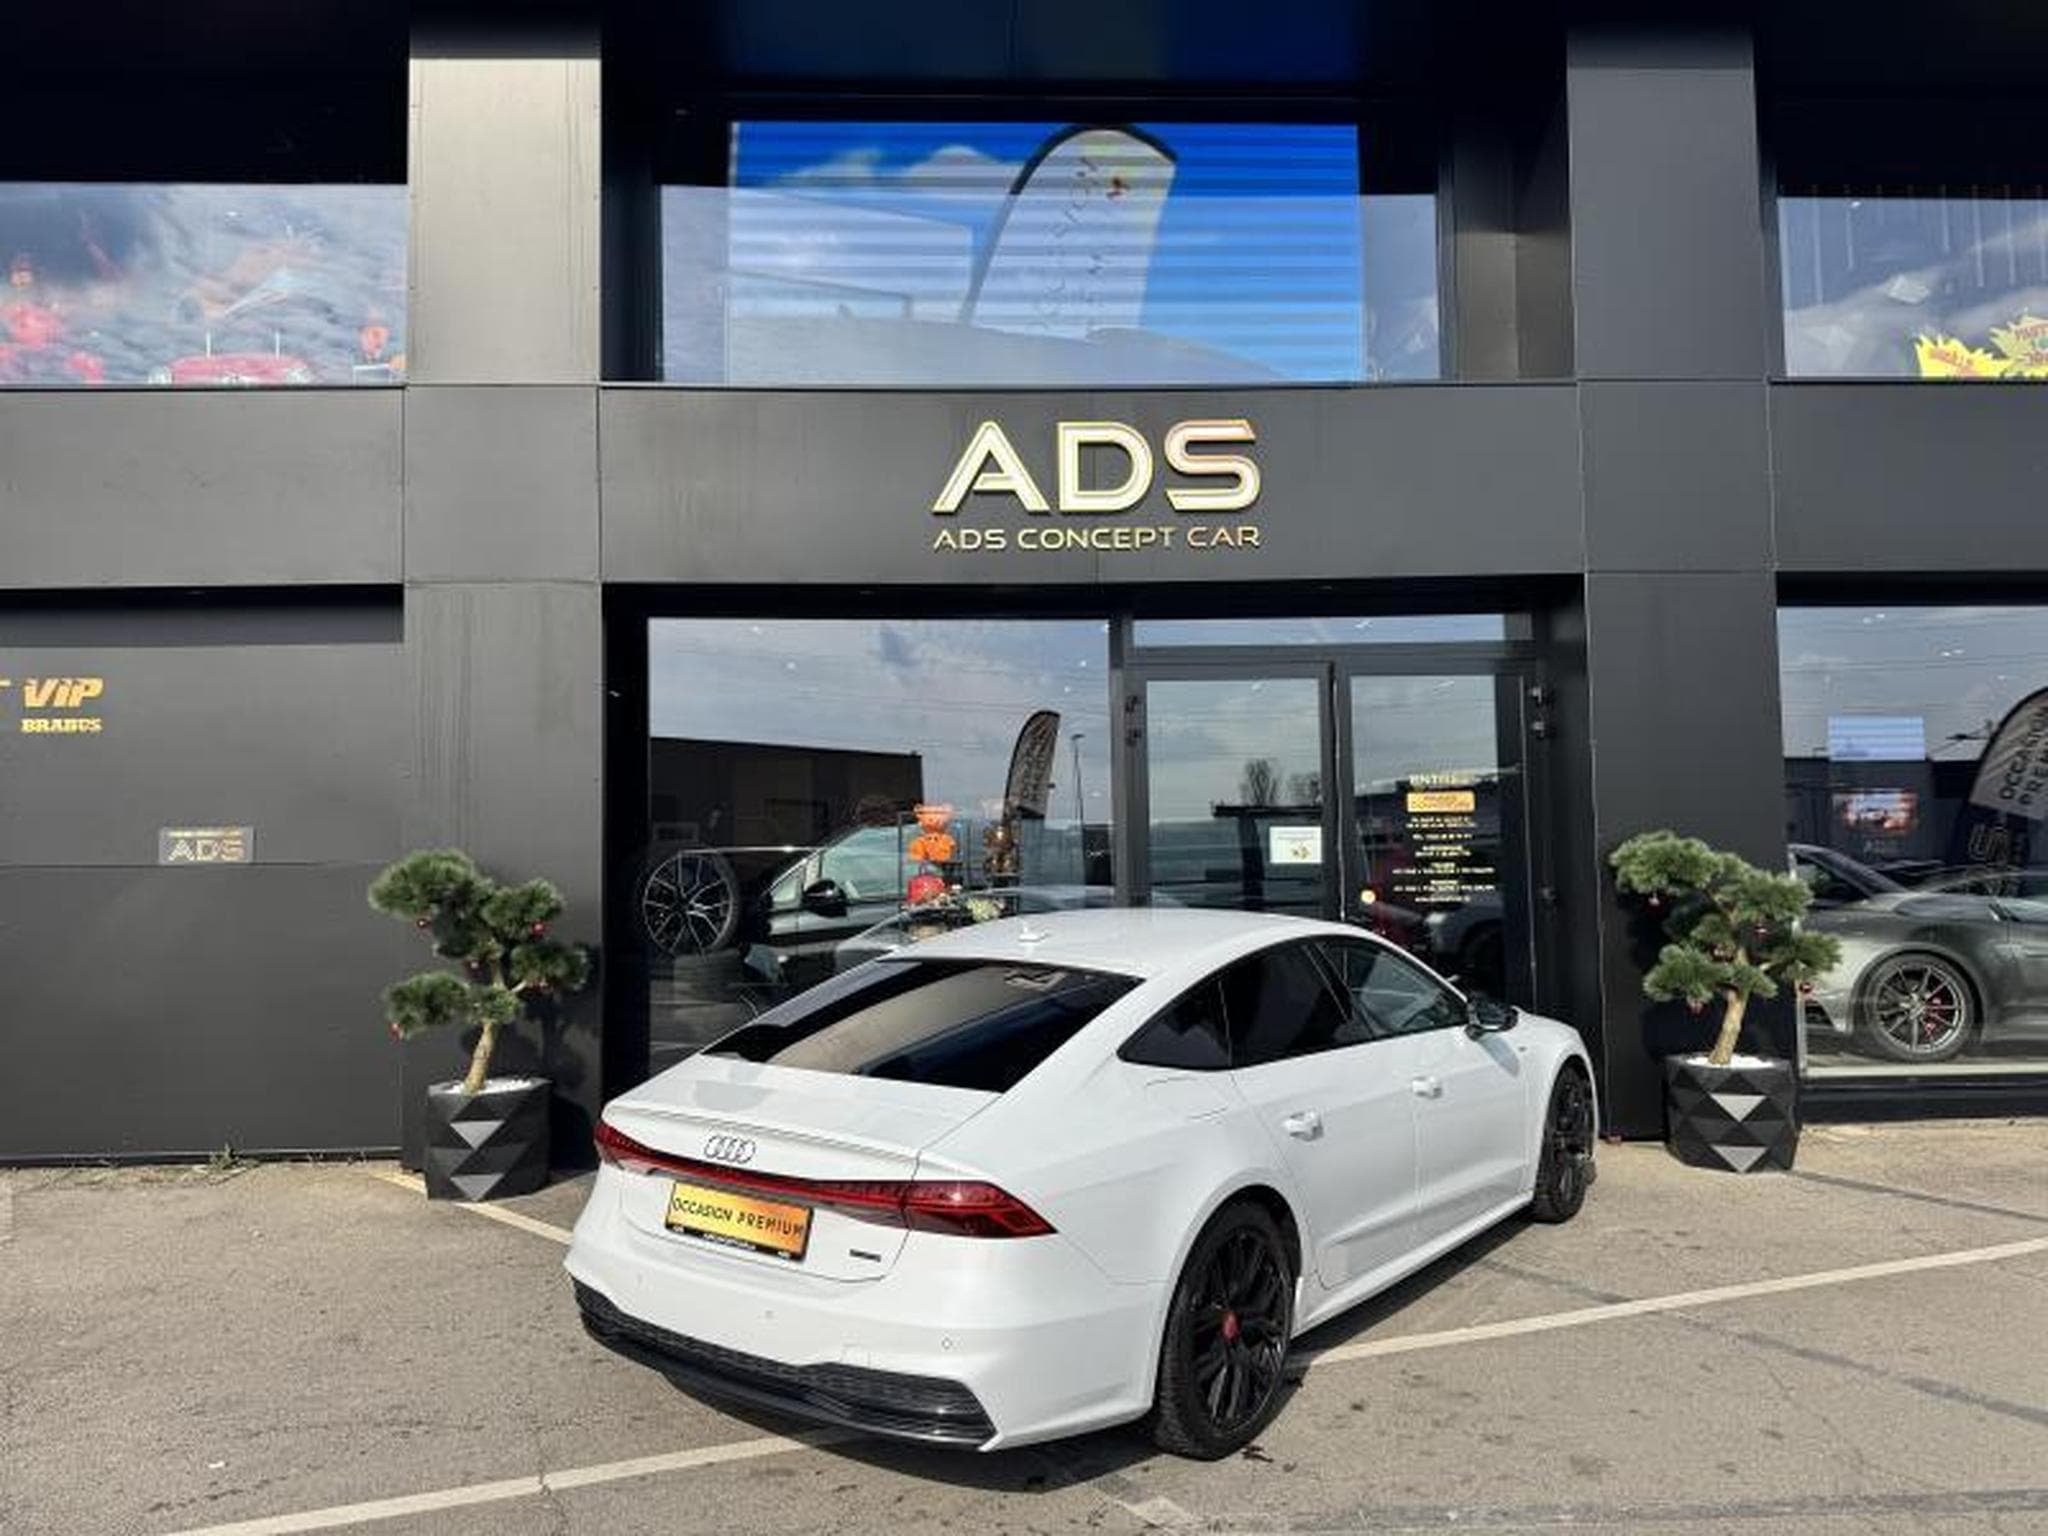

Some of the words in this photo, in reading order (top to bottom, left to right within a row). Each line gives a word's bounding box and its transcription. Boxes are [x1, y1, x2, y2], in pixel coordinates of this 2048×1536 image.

[931, 419, 1262, 512] ADS
[933, 528, 1006, 550] ADS
[1017, 527, 1179, 550] CONCEPT
[1186, 525, 1261, 548] CAR
[168, 838, 245, 862] ADS
[671, 1197, 734, 1222] OCCASION
[736, 1210, 805, 1237] PREMIUM
